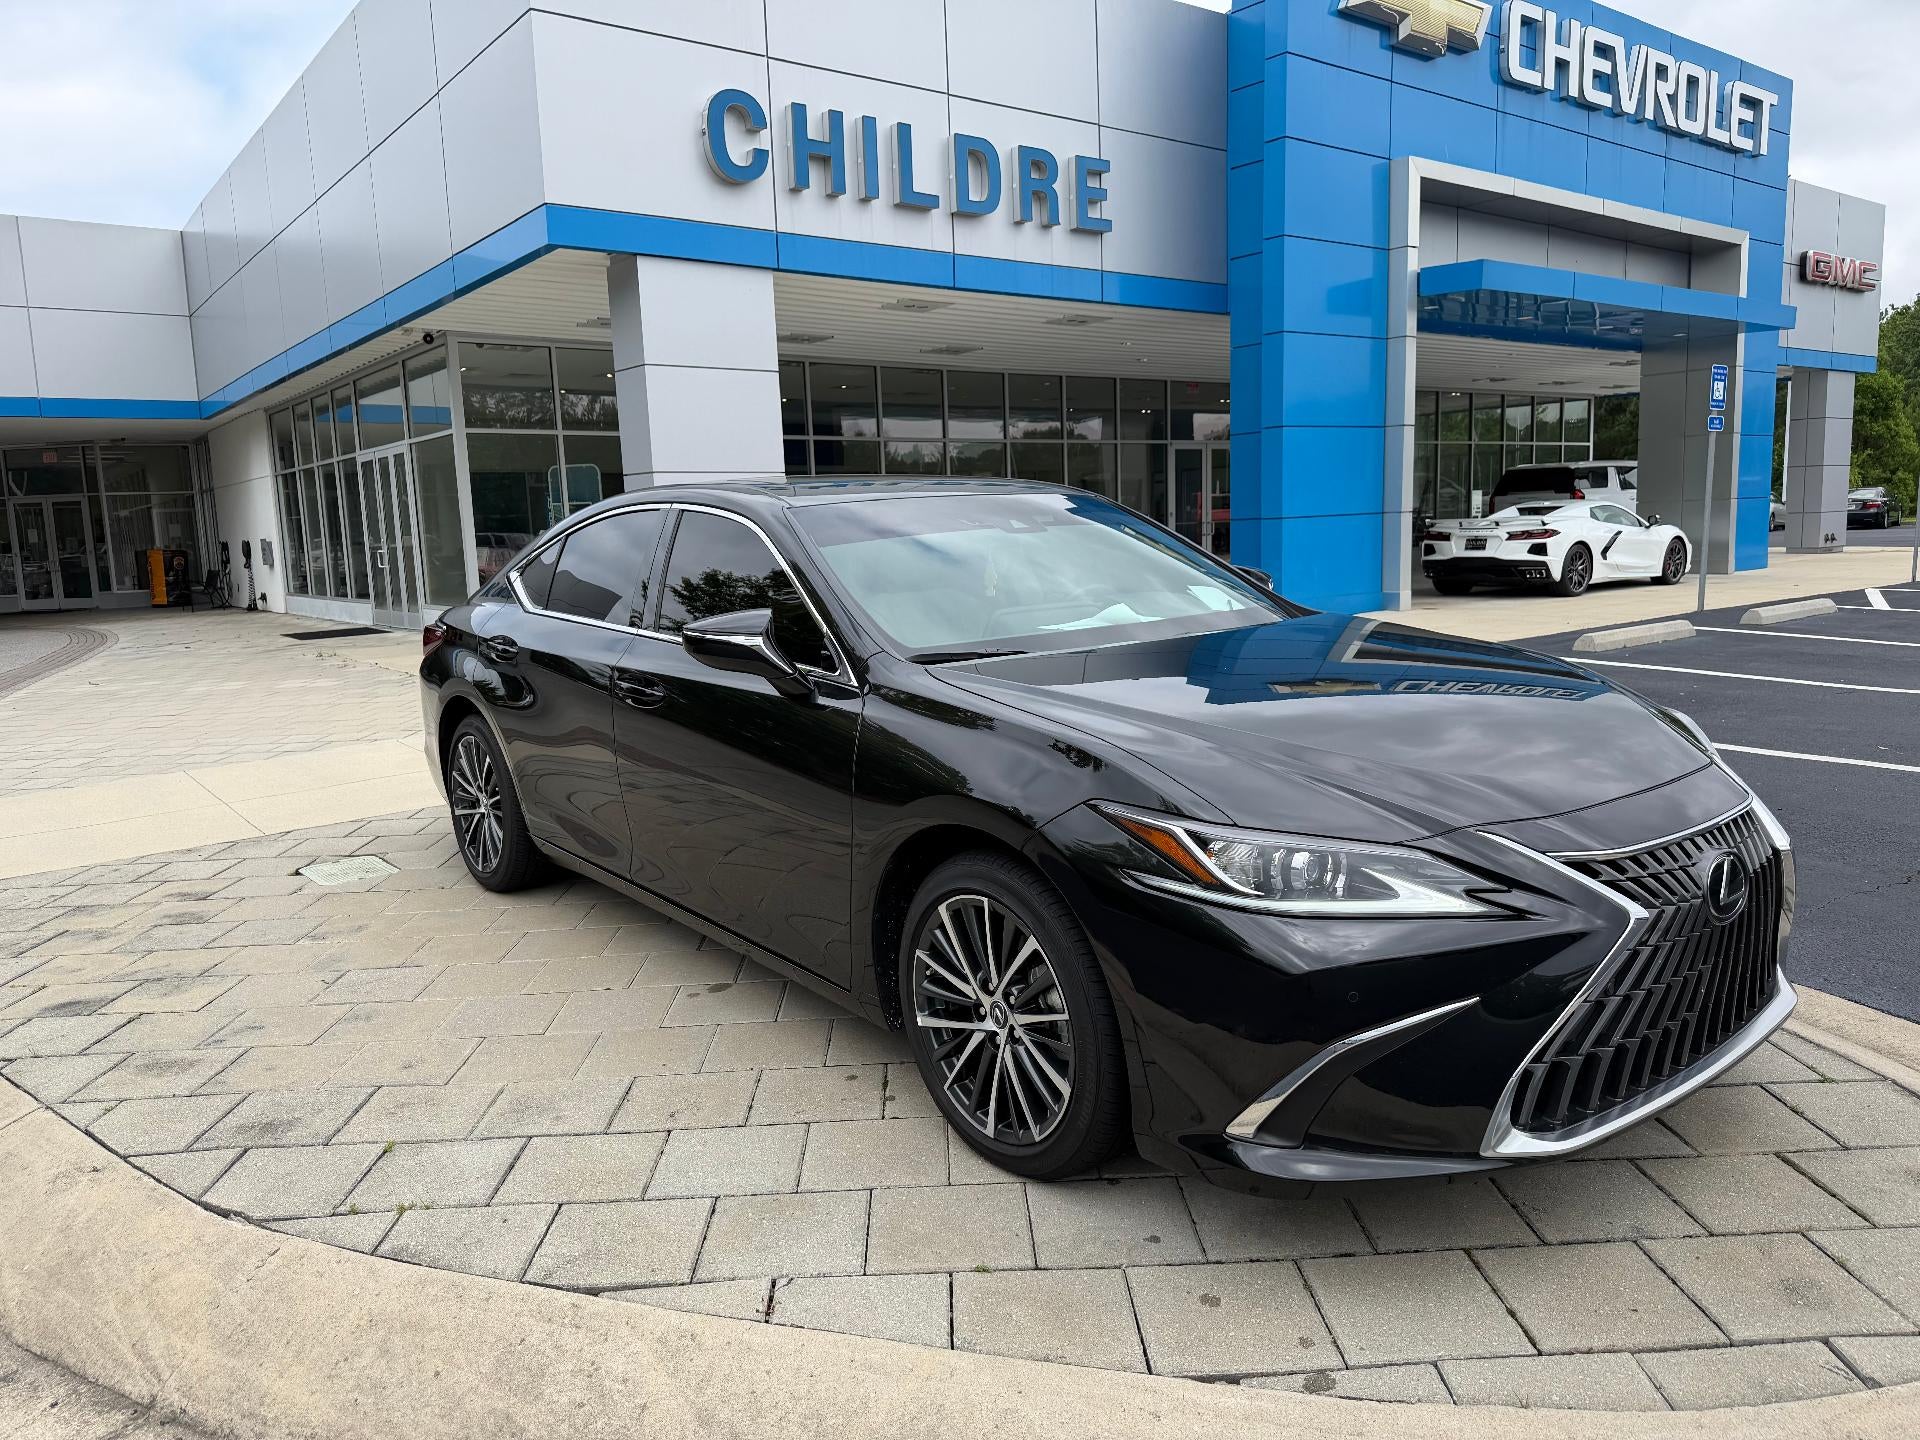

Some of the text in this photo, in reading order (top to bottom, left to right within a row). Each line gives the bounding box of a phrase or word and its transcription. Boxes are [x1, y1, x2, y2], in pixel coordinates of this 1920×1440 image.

[1501, 0, 1778, 157] CHEVROLET
[703, 88, 1113, 233] CHILDRE
[1806, 250, 1878, 292] GMC
